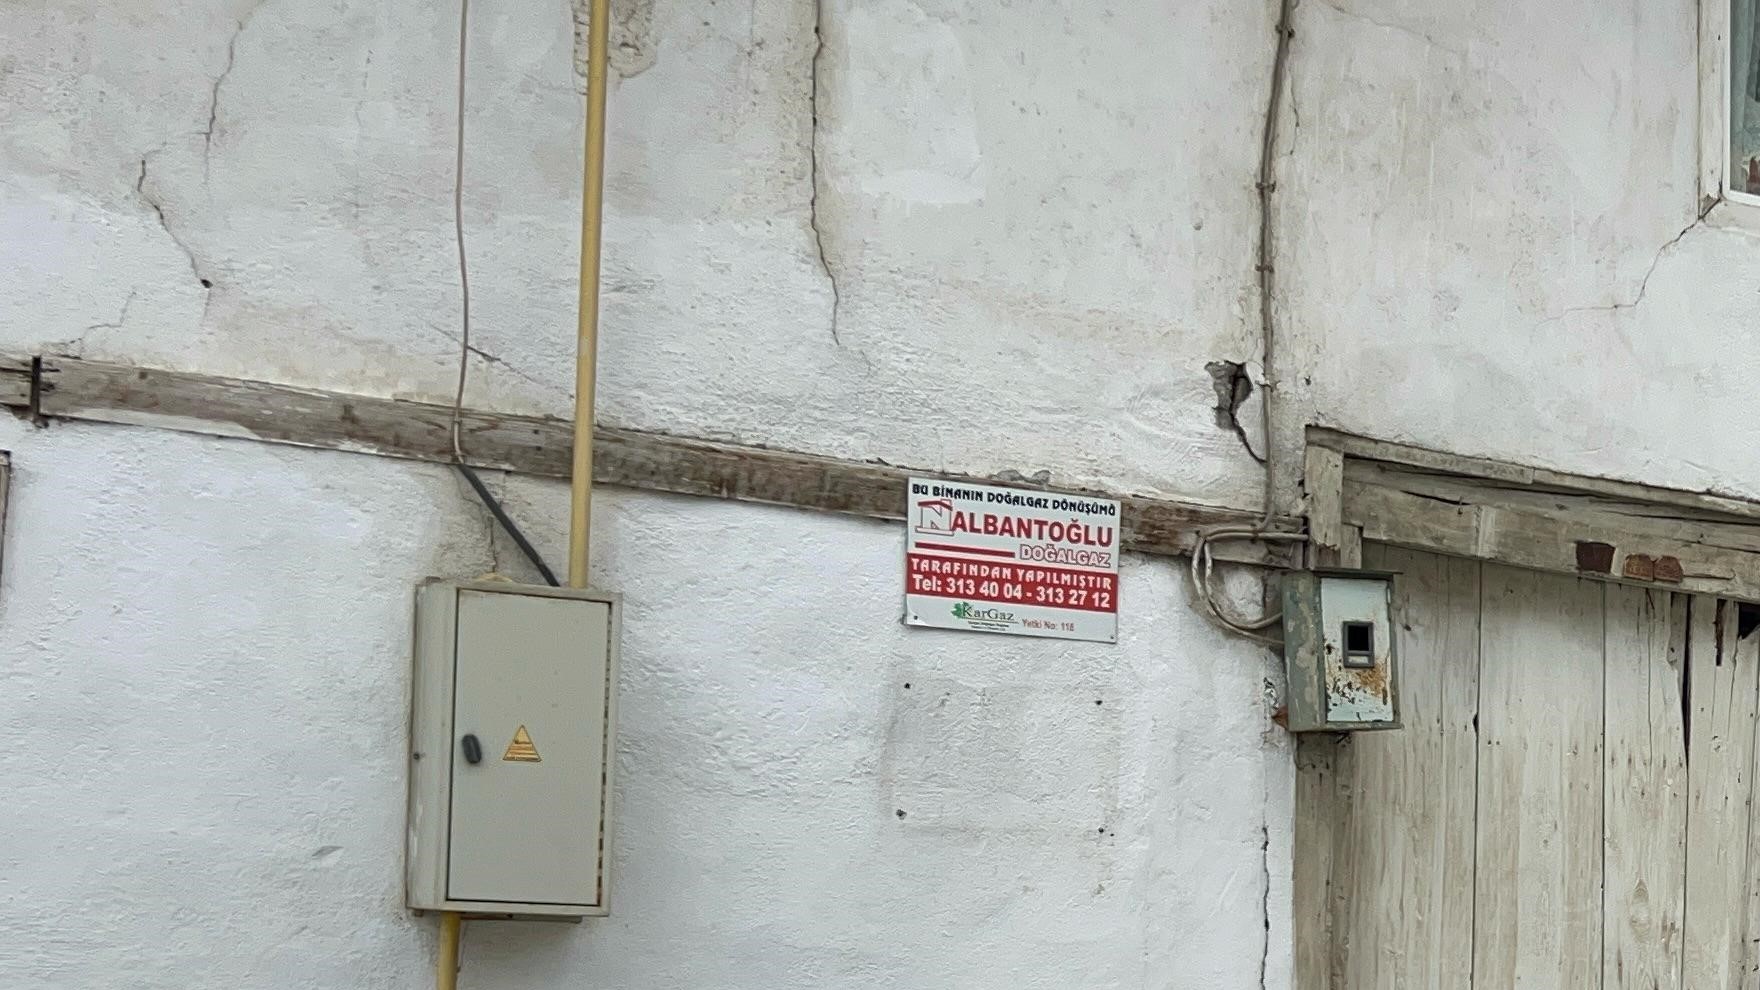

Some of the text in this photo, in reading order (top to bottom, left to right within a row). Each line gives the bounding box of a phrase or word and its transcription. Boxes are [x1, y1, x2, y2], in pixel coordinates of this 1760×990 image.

[932, 485, 983, 502] BİNANIN
[987, 491, 1049, 509] DOĞALGAZ
[1020, 543, 1111, 568] DOĞALGAZ
[911, 558, 1111, 590] TARAFINDAN YAPILMIŞTIR
[912, 574, 942, 592] Tel:
[946, 577, 975, 595] 313
[979, 580, 999, 597] 40
[1003, 583, 1022, 600] 04
[1036, 586, 1064, 604] 313
[1068, 589, 1087, 605] 27
[1092, 591, 1110, 608] 12
[962, 604, 1014, 620] KarGaz
